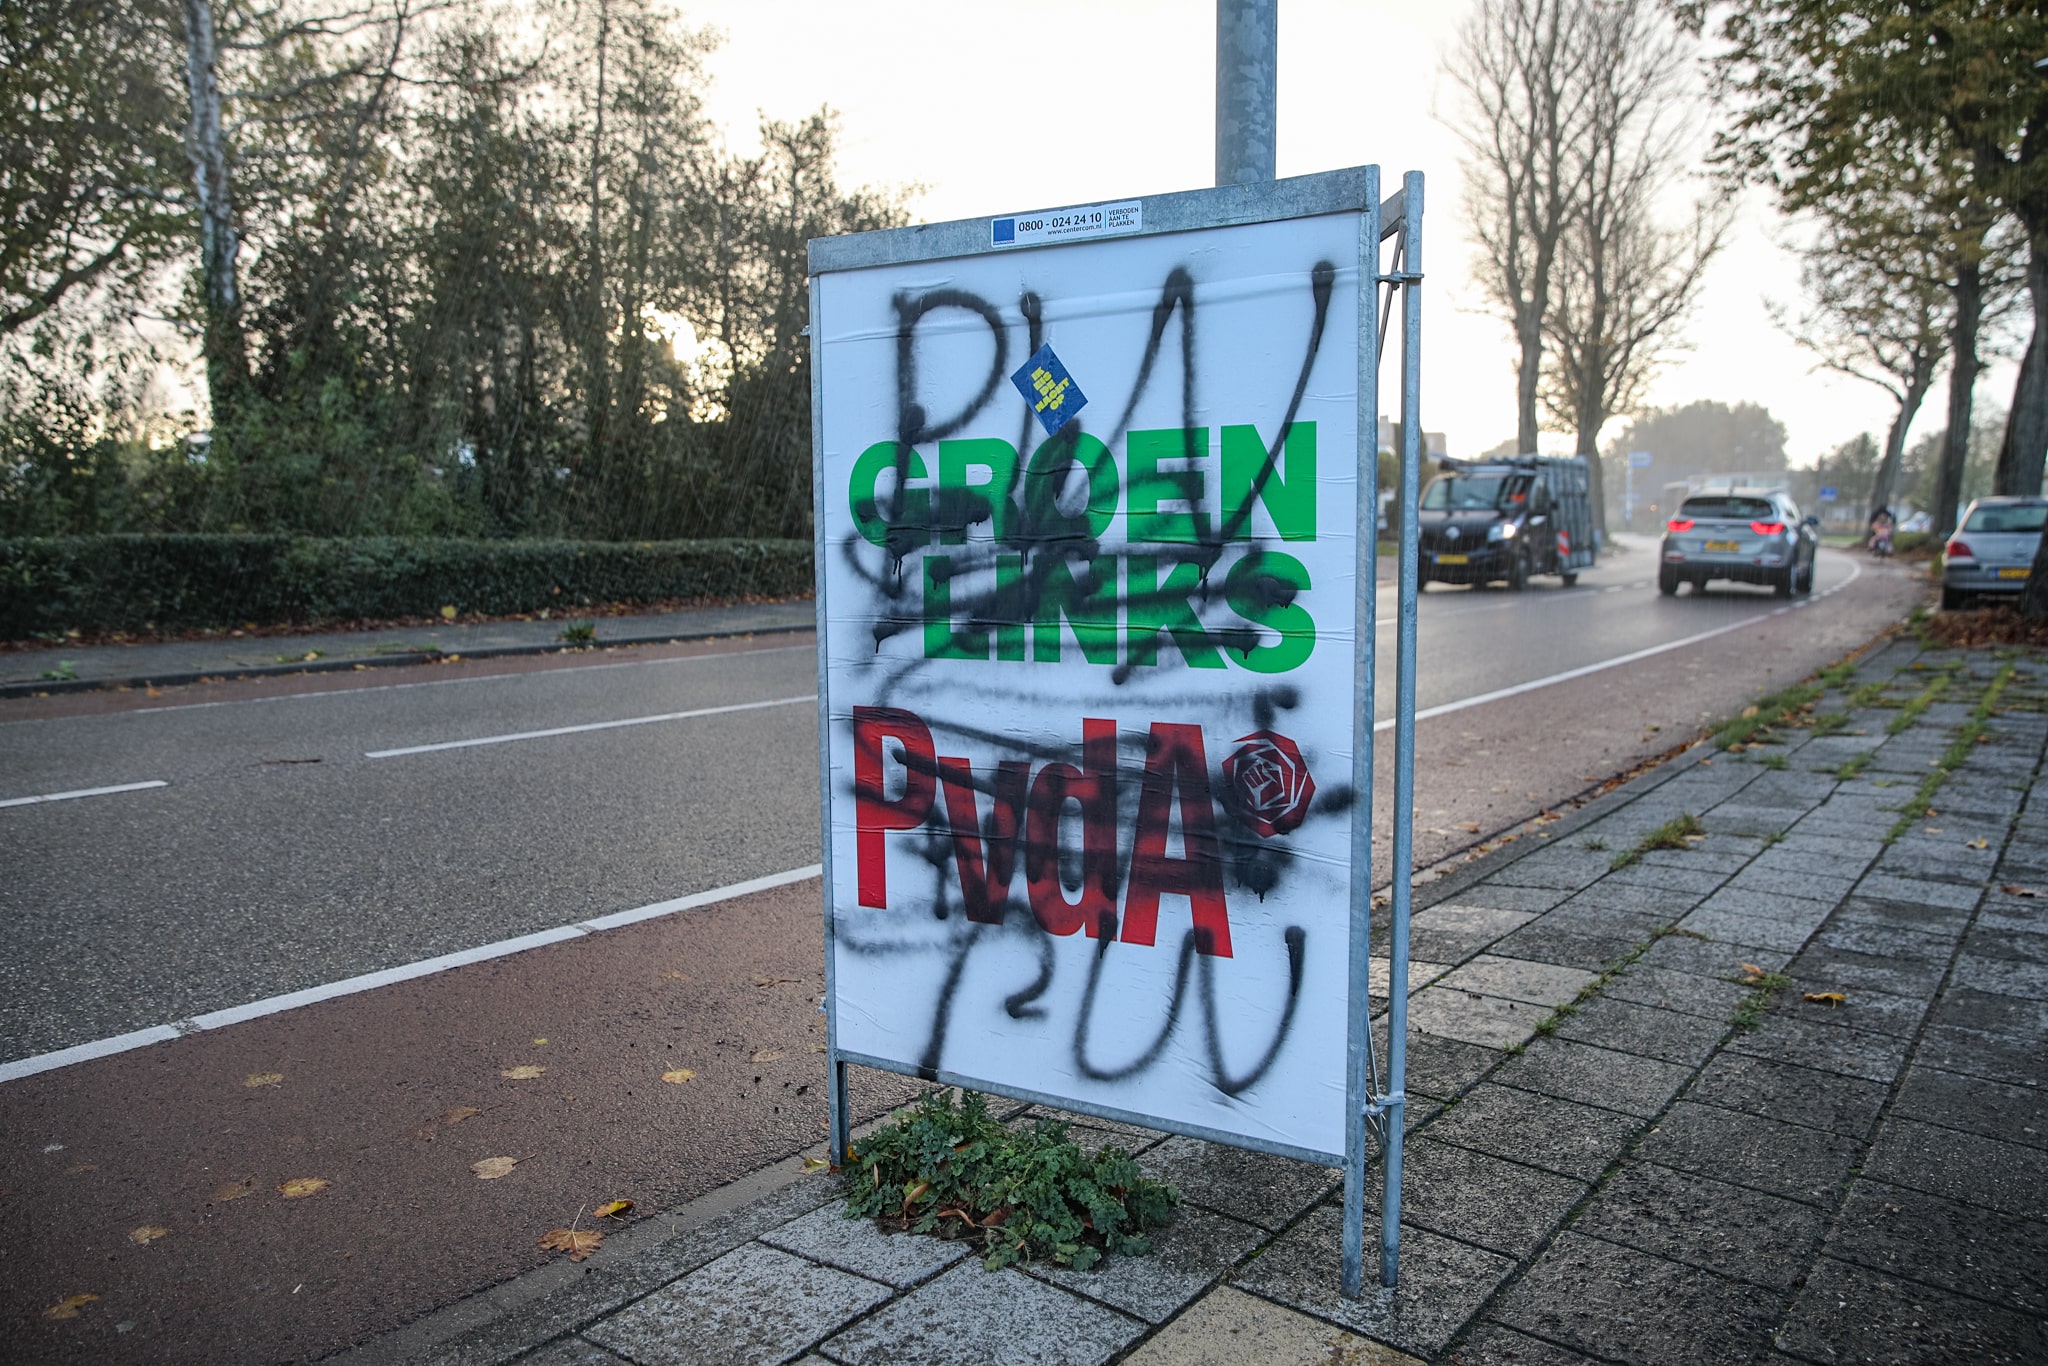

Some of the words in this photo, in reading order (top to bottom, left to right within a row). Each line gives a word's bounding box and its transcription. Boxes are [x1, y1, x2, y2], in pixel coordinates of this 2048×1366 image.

[1108, 206, 1139, 216] VERBODEN
[1018, 219, 1044, 232] 0800
[1052, 216, 1071, 228] 024
[1073, 213, 1087, 225] 24
[1089, 212, 1102, 223] 10
[1047, 223, 1102, 236] www.centercom.nl
[1108, 219, 1135, 228] PLAKKEN
[1031, 366, 1045, 381] IK
[1035, 377, 1069, 413] NACHT
[1039, 379, 1056, 396] DE
[1049, 393, 1065, 411] OP
[848, 420, 1317, 548] GROEN
[922, 550, 1317, 674] LINKS
[852, 705, 1234, 959] PvdA
